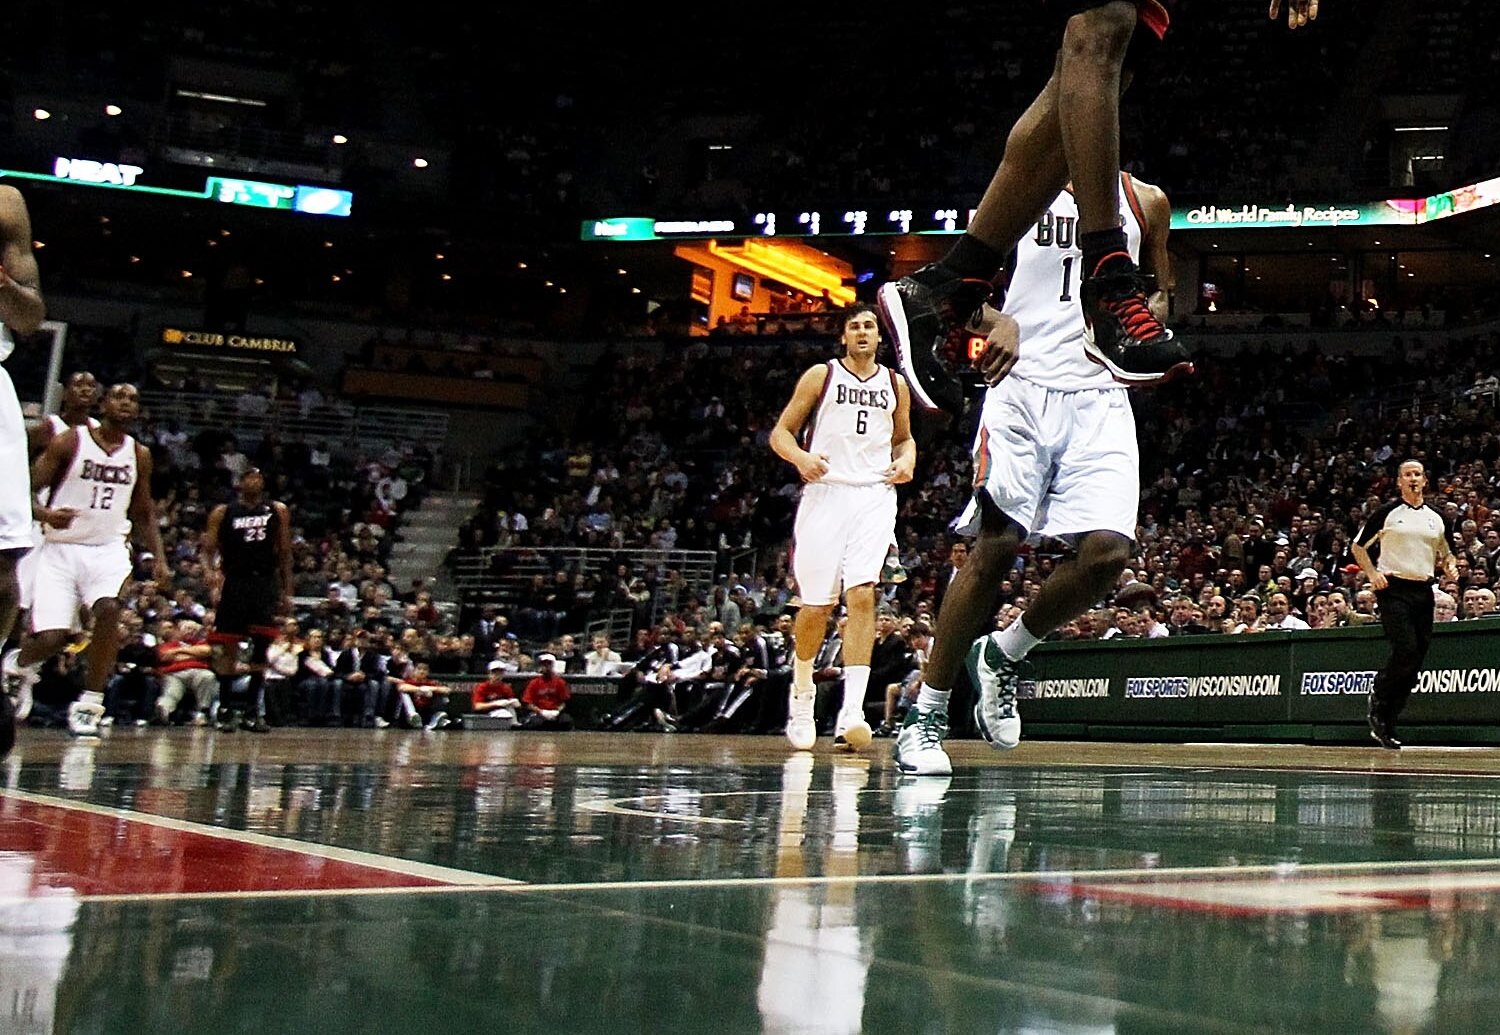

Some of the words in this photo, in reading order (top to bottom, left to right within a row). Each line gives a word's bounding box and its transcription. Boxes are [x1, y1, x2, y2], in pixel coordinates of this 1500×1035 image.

[55, 156, 144, 187] HEAT
[1186, 205, 1216, 224] Old
[1216, 204, 1258, 224] World
[1258, 203, 1303, 227] Family
[1303, 205, 1361, 227] Recipes
[184, 331, 225, 346] CLUB
[227, 335, 297, 352] CAMBRIA
[835, 383, 889, 411] BUCKS
[856, 410, 869, 435] 6
[79, 459, 133, 485] BUCKS
[90, 486, 115, 510] 12
[232, 513, 273, 530] HEAT
